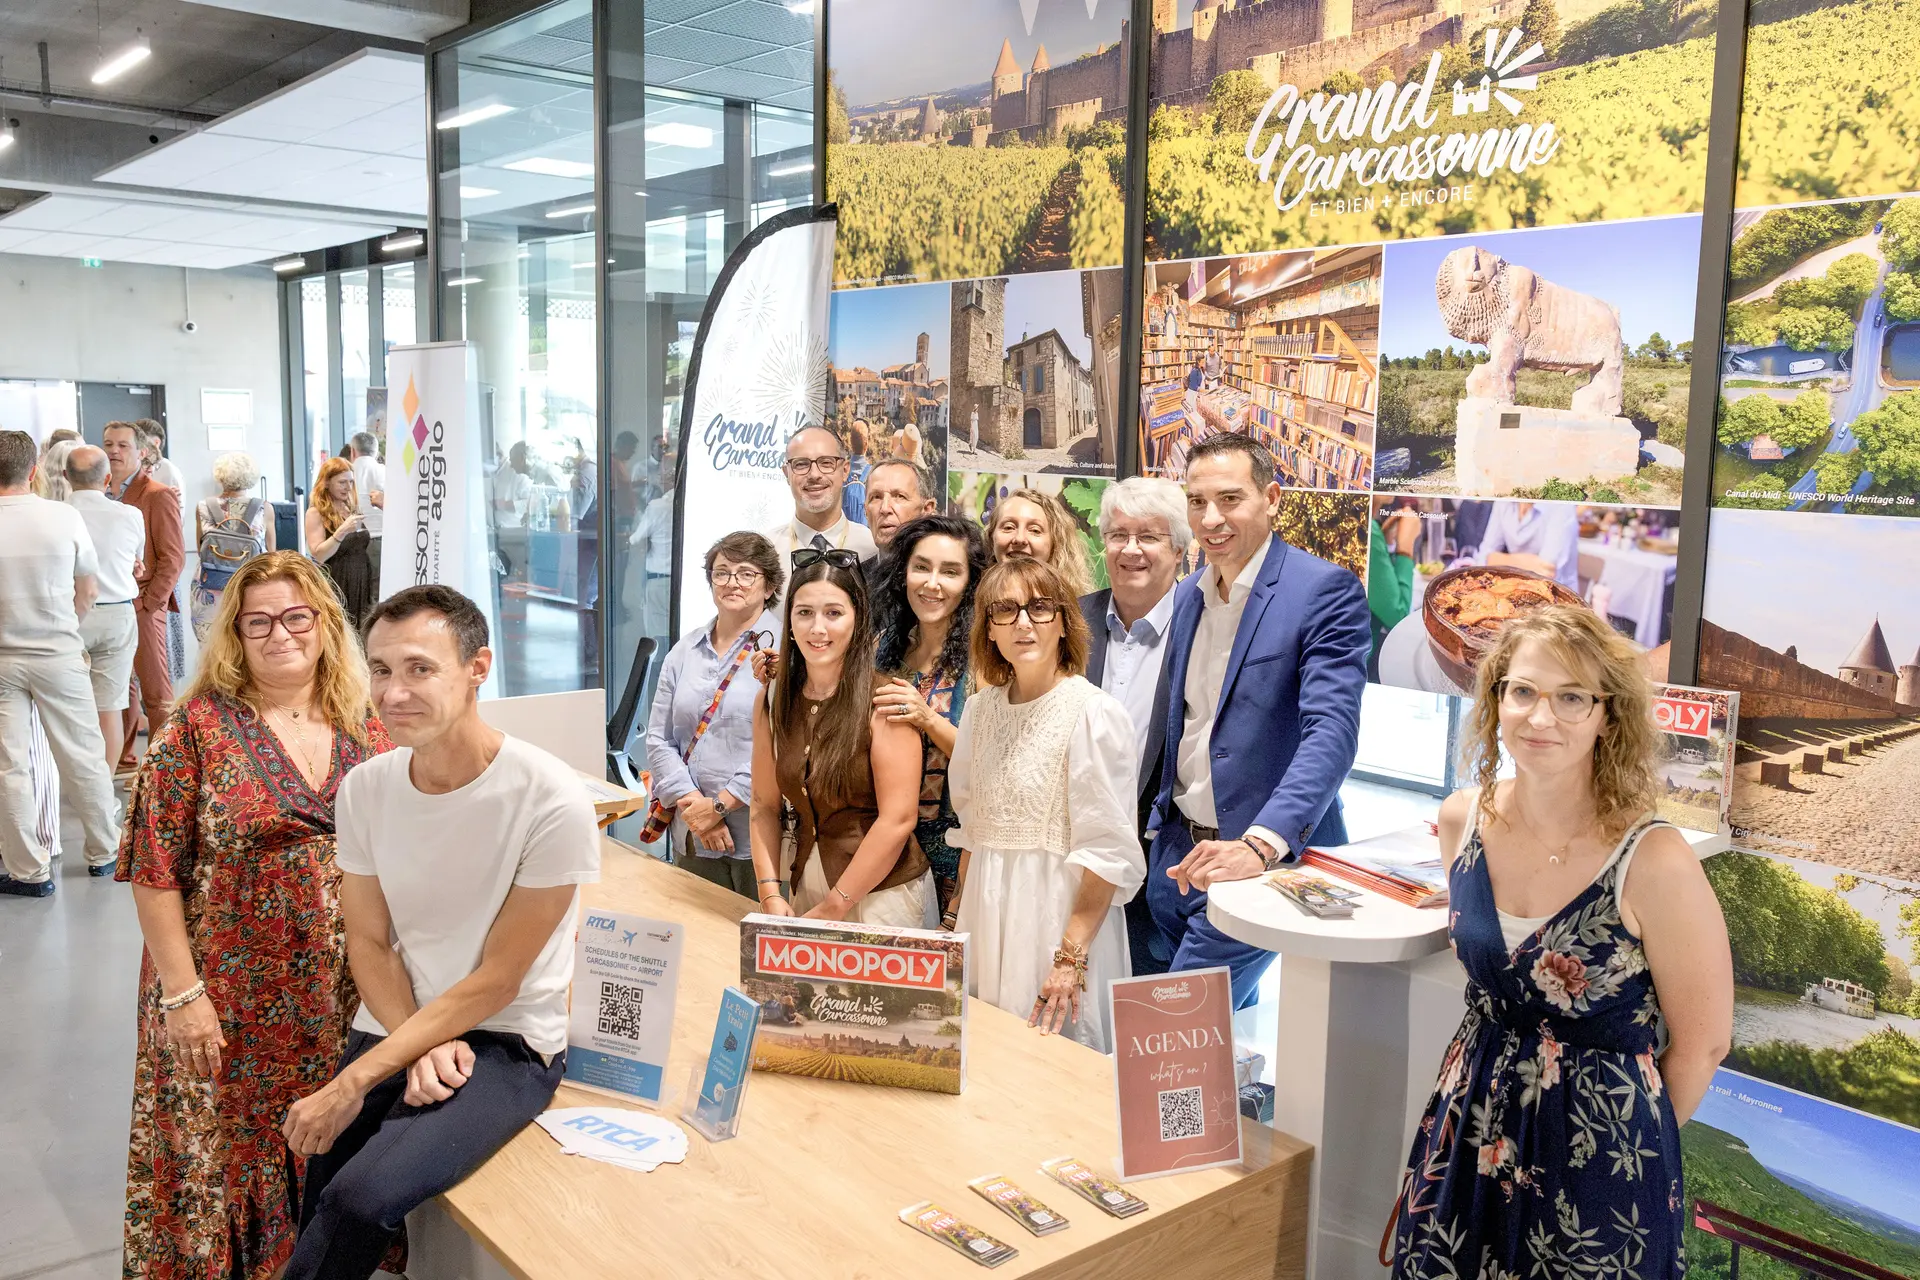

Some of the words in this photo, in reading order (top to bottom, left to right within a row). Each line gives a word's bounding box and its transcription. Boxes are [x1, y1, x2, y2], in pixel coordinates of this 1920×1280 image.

[1244, 50, 1443, 184] Grand
[1273, 122, 1562, 211] Carcassonne
[1310, 200, 1330, 218] ET
[1336, 196, 1375, 215] BIEN
[1400, 185, 1475, 208] ENCORE
[703, 412, 779, 456] Grand
[713, 442, 787, 471] Carcasso
[1379, 477, 1400, 485] Marble
[415, 454, 431, 585] ssonne
[429, 420, 447, 521] agglo
[1725, 489, 1749, 499] Canal
[1750, 491, 1761, 499] du
[1762, 491, 1781, 500] Midi
[1788, 492, 1825, 502] UNESCO
[1827, 493, 1853, 503] World
[1855, 494, 1894, 506] Heritage
[1896, 495, 1915, 505] Site
[1379, 508, 1390, 516] The
[1419, 511, 1449, 520] Cassoulet
[1652, 702, 1707, 731] OLY
[1735, 828, 1752, 839] City
[586, 916, 616, 931] RTCA
[585, 945, 618, 959] SCHEDULES
[620, 952, 627, 960] OF
[628, 953, 640, 963] THE
[640, 956, 667, 968] SHUTTLE
[586, 956, 629, 971] CARCASSONNE
[638, 966, 663, 977] AIRPORT
[763, 940, 941, 983] MONOPOLY
[725, 998, 734, 1011] Le
[735, 1003, 749, 1021] Petit
[810, 994, 861, 1014] Grand
[818, 1008, 889, 1026] Carcassonne
[727, 1011, 744, 1030] Train
[1128, 1026, 1225, 1058] AGENDA
[1150, 1061, 1184, 1087] what's
[1186, 1067, 1199, 1075] on
[1201, 1062, 1208, 1074] ?
[1715, 1085, 1732, 1097] trail
[1738, 1092, 1783, 1114] Mayronnes
[562, 1115, 661, 1151] RTCA
